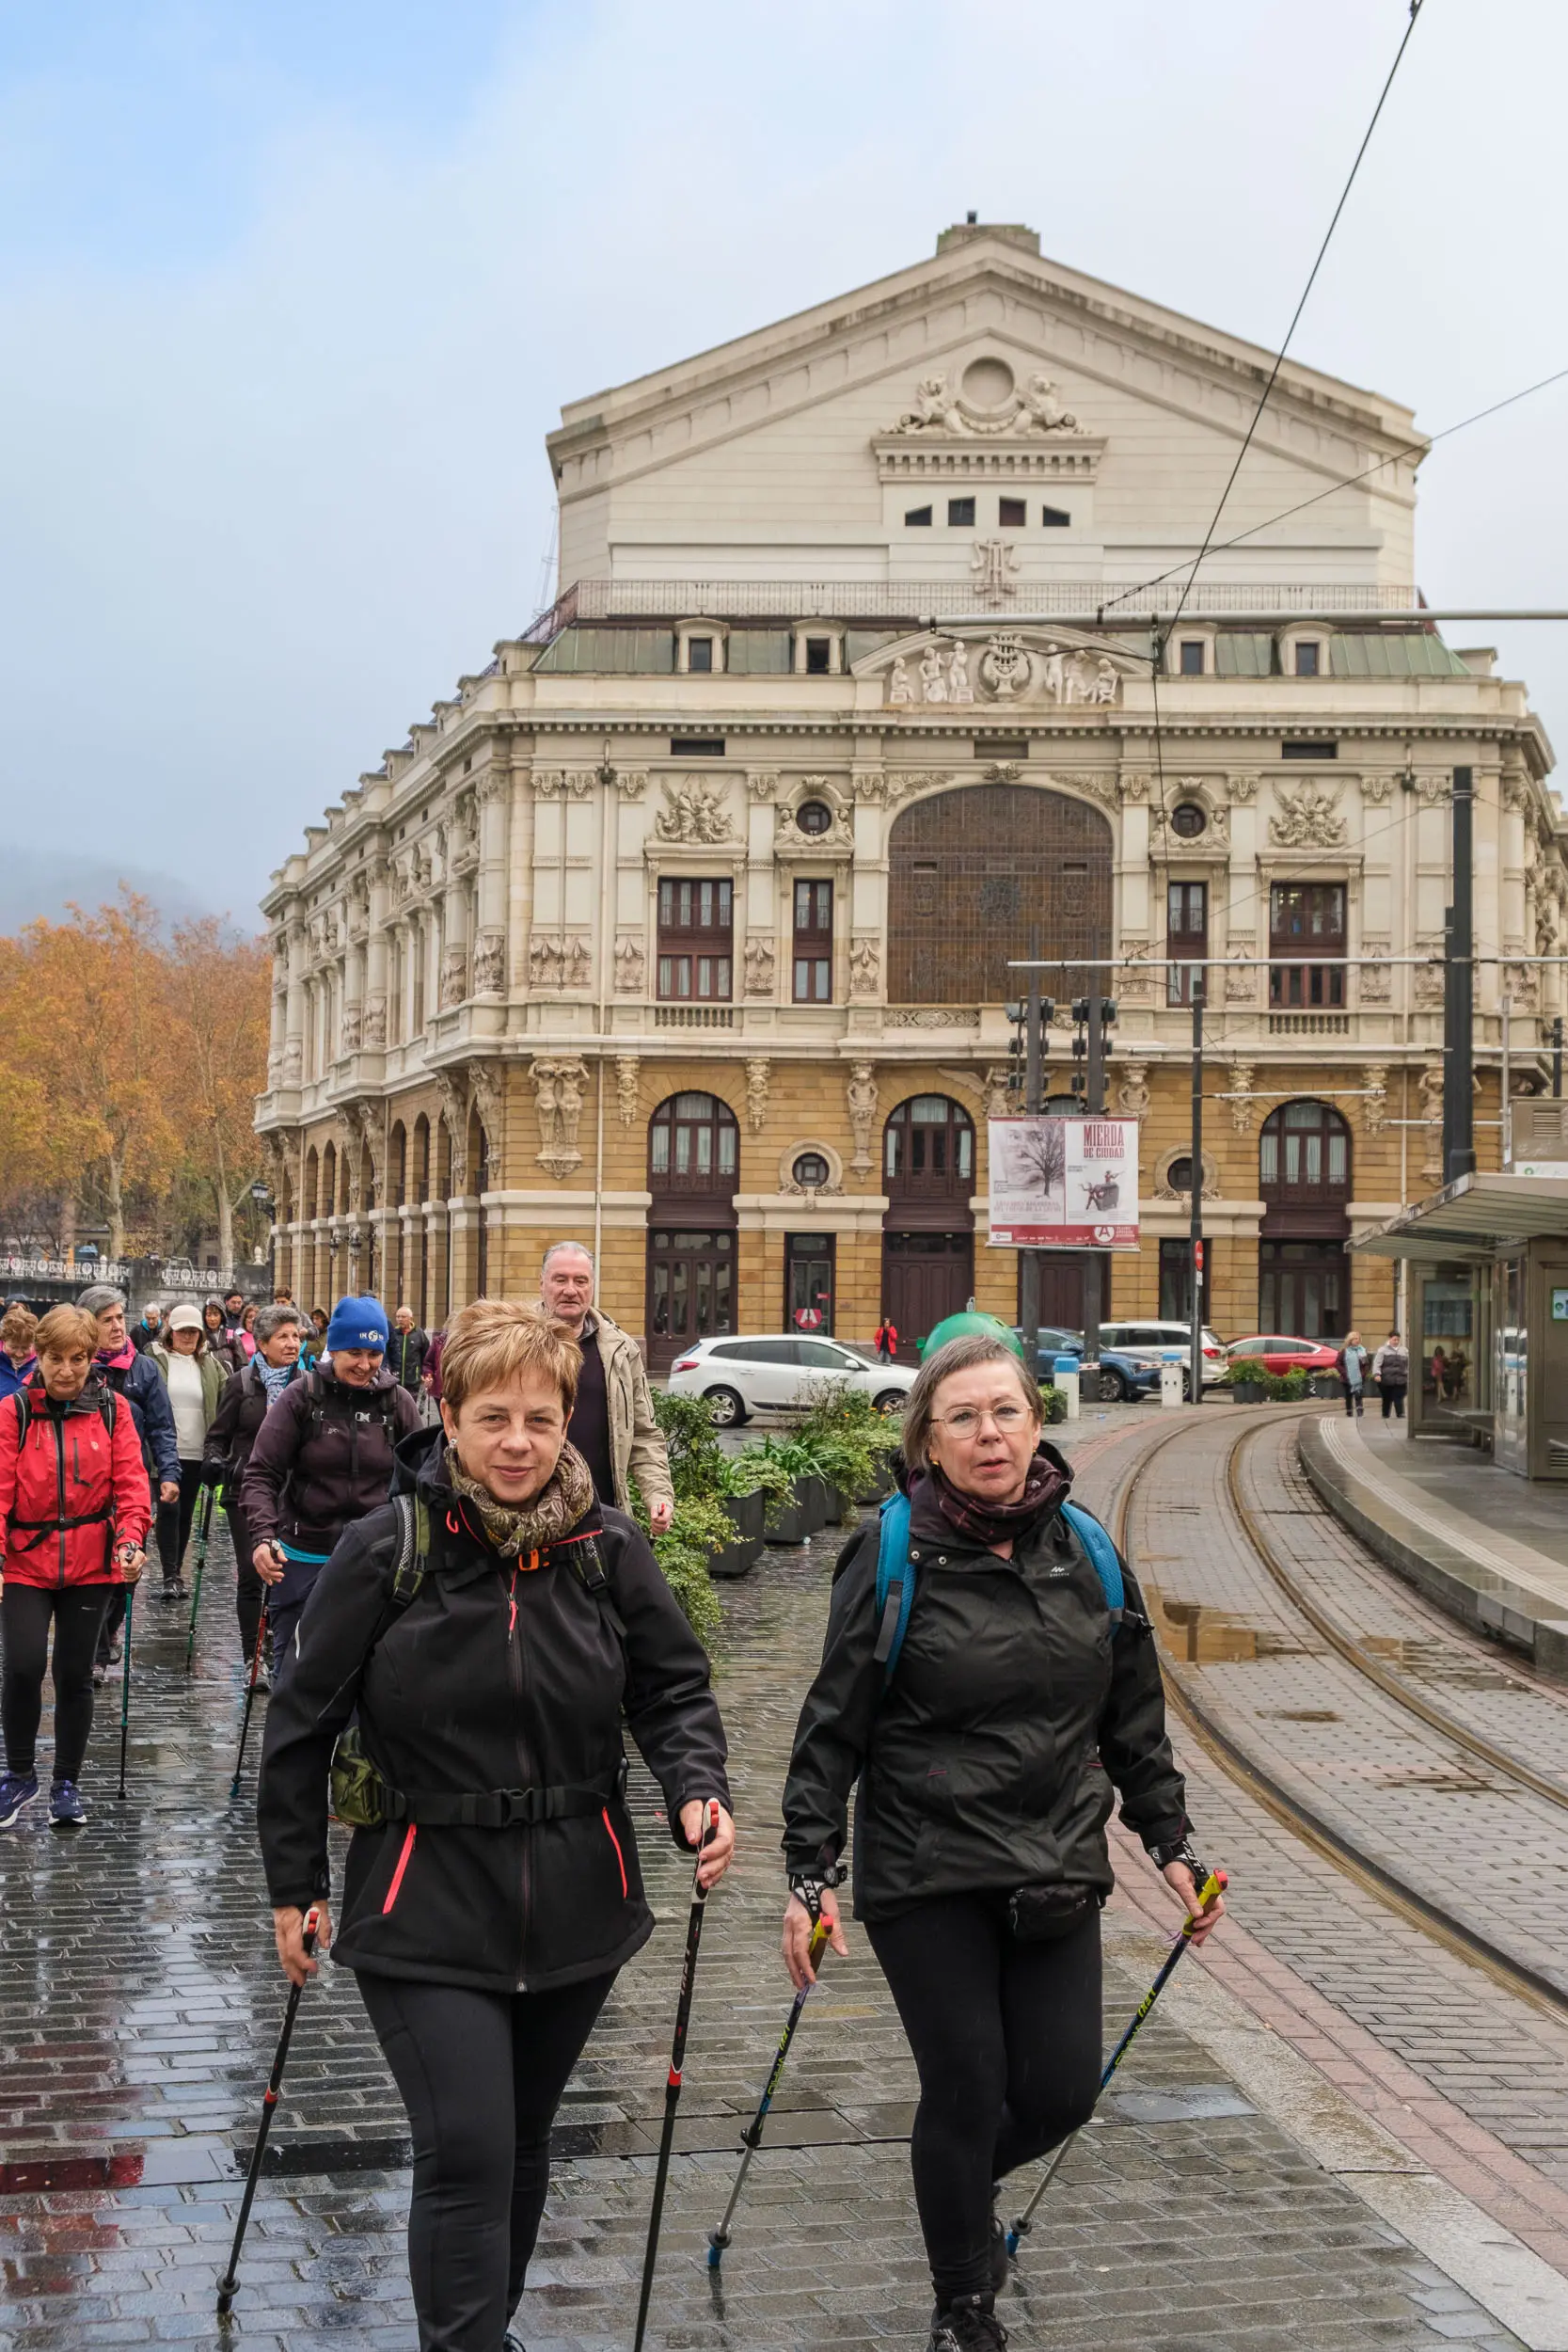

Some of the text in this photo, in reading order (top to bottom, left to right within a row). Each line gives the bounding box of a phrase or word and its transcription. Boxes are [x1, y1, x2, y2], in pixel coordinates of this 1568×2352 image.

[1084, 1124, 1124, 1146] MIERDA
[1084, 1148, 1124, 1158] DE CIUDAD
[1137, 1986, 1157, 2018] LEKI
